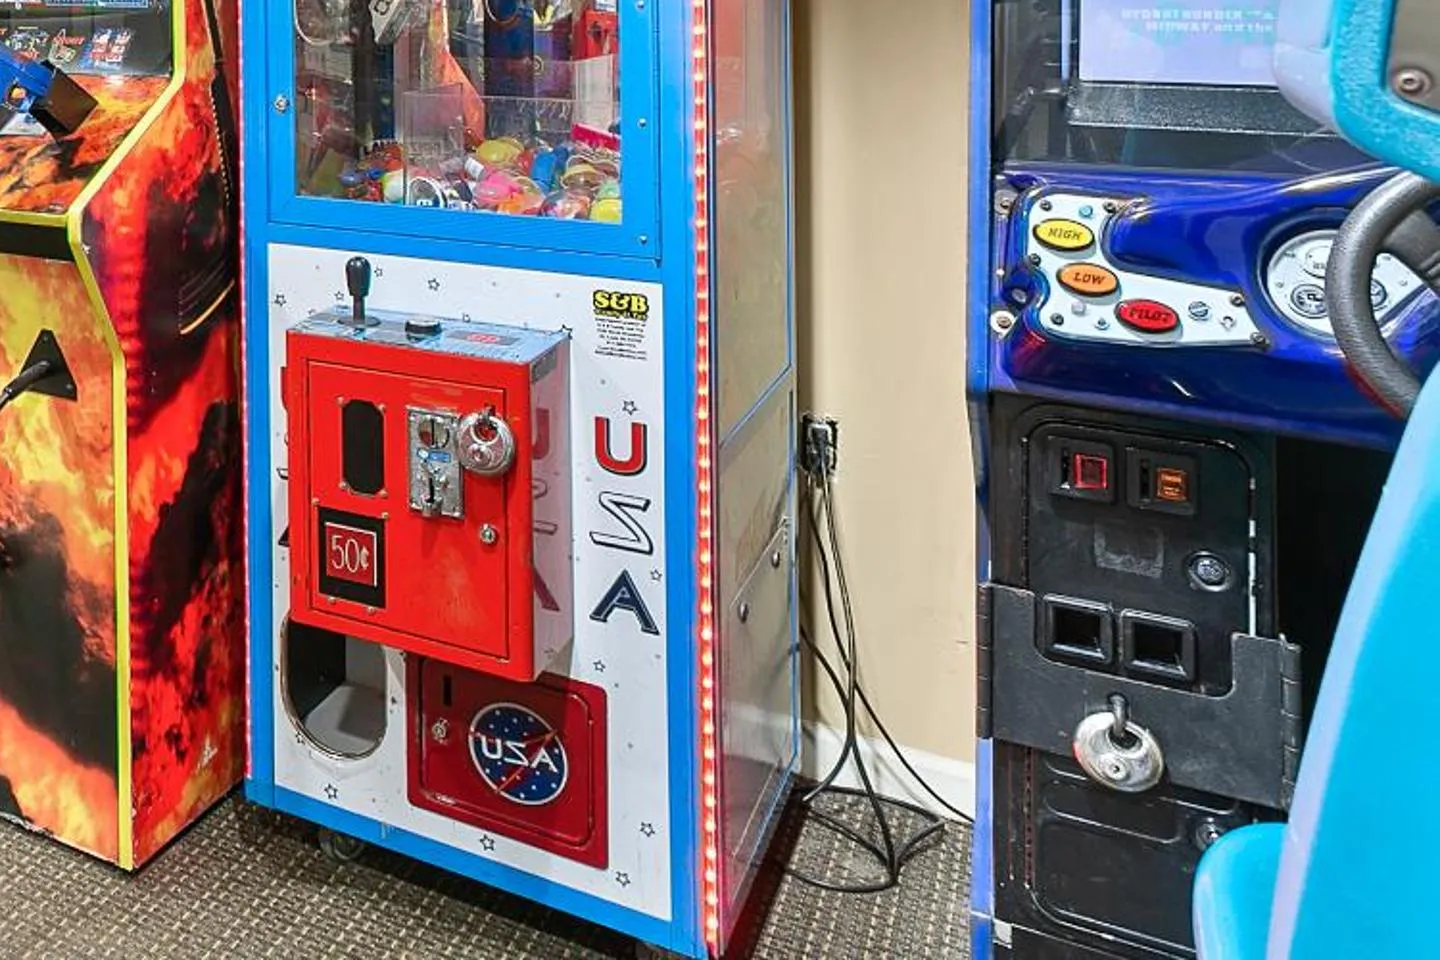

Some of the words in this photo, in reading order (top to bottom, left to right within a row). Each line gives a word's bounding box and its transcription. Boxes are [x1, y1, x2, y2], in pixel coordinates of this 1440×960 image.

[1047, 226, 1082, 240] HIGH
[1073, 271, 1106, 286] LOW
[593, 290, 649, 314] S&B
[1128, 307, 1172, 323] PILOT
[330, 536, 370, 573] 50¢
[480, 735, 559, 774] USA
